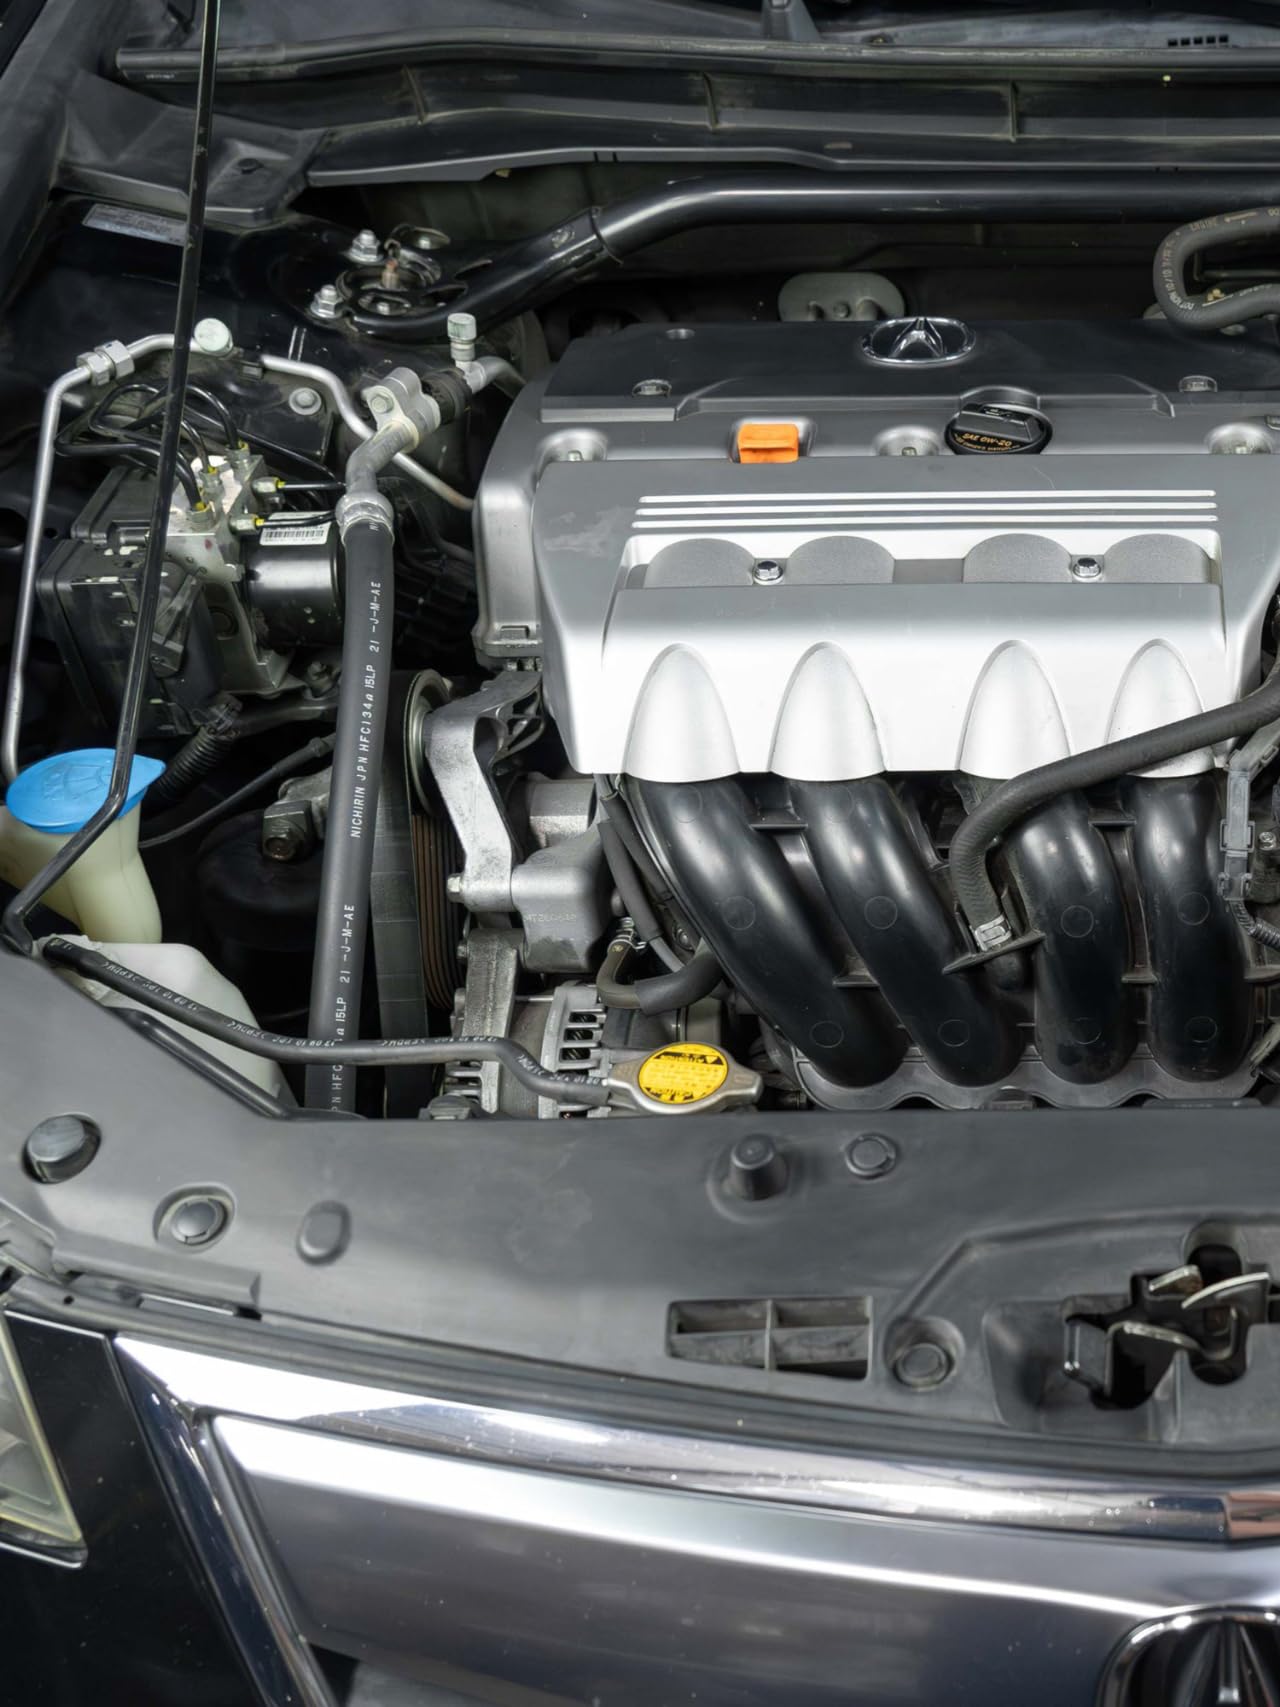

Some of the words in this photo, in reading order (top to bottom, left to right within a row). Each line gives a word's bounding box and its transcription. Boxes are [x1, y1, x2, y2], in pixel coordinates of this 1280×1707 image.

[962, 433, 979, 442] SAE
[356, 756, 368, 781] JPN
[350, 786, 366, 838] NICHIRIN
